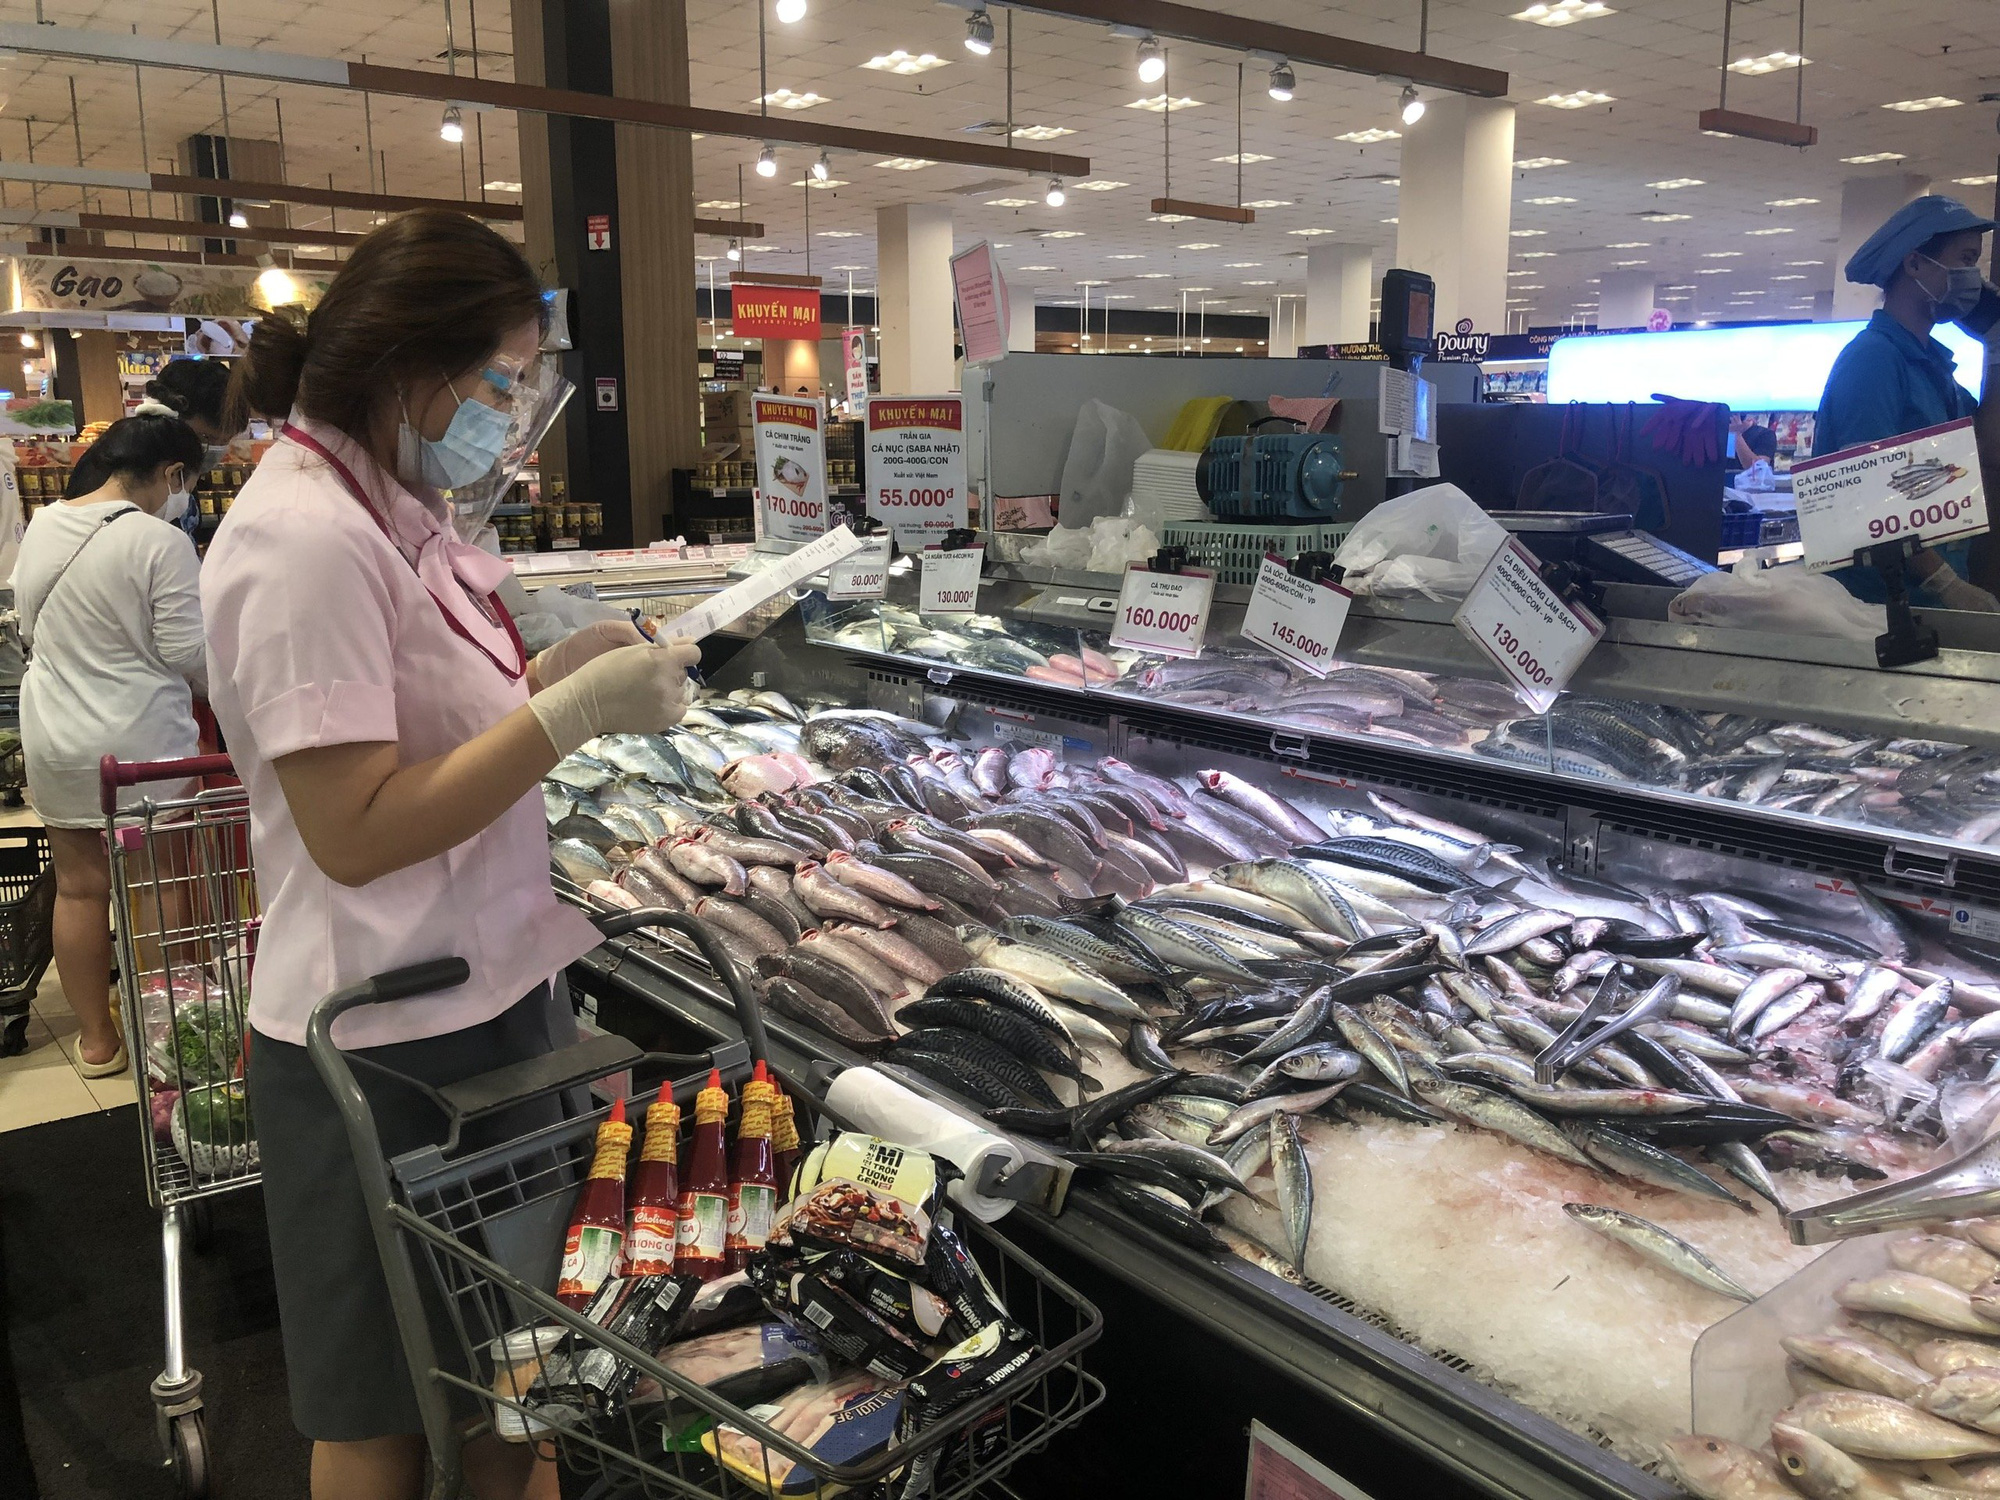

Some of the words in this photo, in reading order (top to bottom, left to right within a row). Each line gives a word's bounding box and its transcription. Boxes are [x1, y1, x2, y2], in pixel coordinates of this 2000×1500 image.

[51, 265, 123, 307] Gạo
[738, 301, 787, 319] KHUYẾN
[1438, 334, 1489, 354] Downy
[879, 404, 926, 421] KHUYẾN
[774, 432, 789, 440] CHIM
[871, 443, 883, 453] CÁ
[886, 445, 904, 454] NỤC
[906, 445, 932, 454] (SABA
[934, 443, 960, 454] NHẬT)
[883, 457, 948, 465] 200G-400G/CON
[1796, 471, 1812, 487] CÁ
[1814, 468, 1837, 483] NỤC
[1840, 459, 1878, 476] THUÔN
[1880, 451, 1907, 464] TƯƠI
[880, 488, 954, 507] 55.000đ
[1798, 476, 1862, 500] 8-12CON/KG
[766, 494, 823, 519] 170.000đ
[1868, 495, 1972, 539] 90.000đ
[1261, 575, 1304, 600] 400G-600G/CON
[1307, 596, 1316, 605] VP
[1264, 564, 1272, 574] CÁ
[1273, 570, 1283, 580] LÓC
[1284, 575, 1297, 585] LÀM
[1297, 580, 1314, 593] SẠCH
[937, 591, 974, 603] 130.000đ
[1496, 565, 1542, 614] 400G-600G/CON
[1543, 613, 1554, 625] VP
[1503, 554, 1513, 566] CÁ
[1526, 576, 1546, 602] HỒNG
[1544, 596, 1561, 616] LÀM
[1559, 612, 1577, 634] SẠCH
[1126, 606, 1200, 633] 160.000đ
[1272, 621, 1328, 658] 145.000đ
[1492, 622, 1554, 686] 130.000đ
[875, 1146, 905, 1168] MÌ
